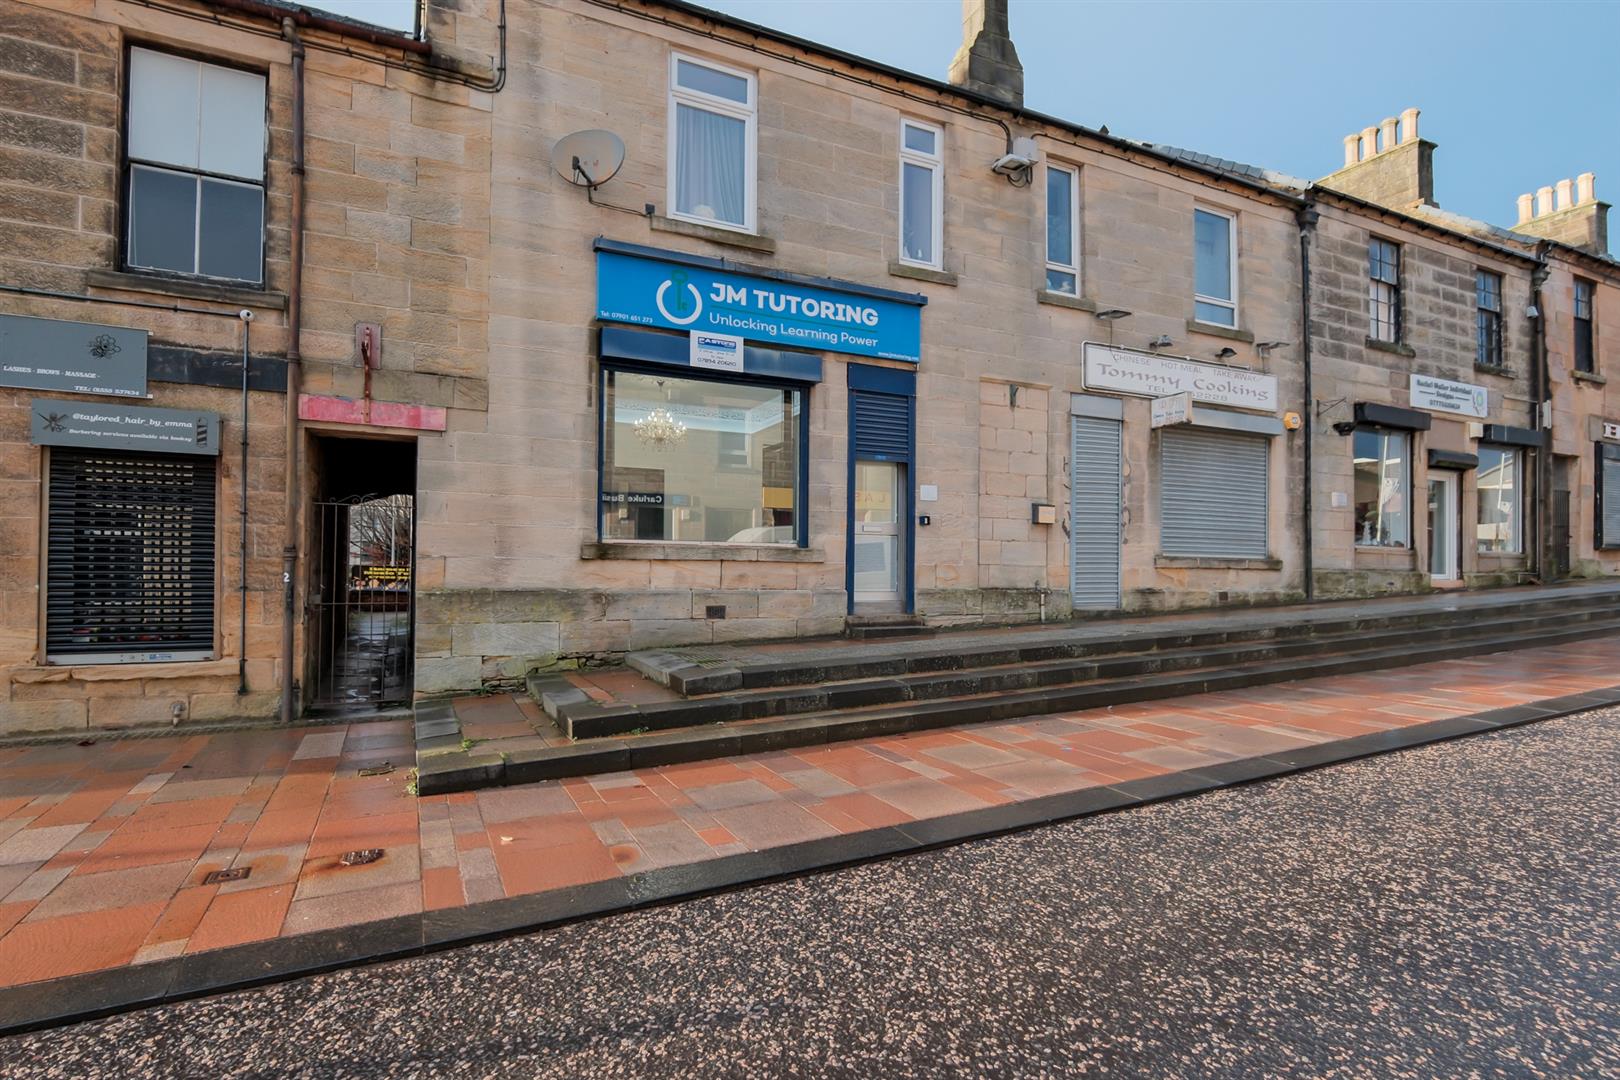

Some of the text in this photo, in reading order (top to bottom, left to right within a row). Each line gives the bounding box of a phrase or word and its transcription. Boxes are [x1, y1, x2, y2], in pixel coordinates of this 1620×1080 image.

[710, 282, 878, 326] JM TUTORING
[709, 311, 878, 348] Unlocking Learning Power
[1113, 354, 1151, 366] CHINESE
[1160, 361, 1177, 370] HOT
[1181, 364, 1203, 373] MEAL
[1213, 369, 1231, 377] TAKE
[1096, 363, 1269, 401] Tommy Cooking
[1146, 385, 1168, 394] TEL
[72, 412, 193, 428] @taylored_hair_by_emma
[283, 572, 290, 582] 2
